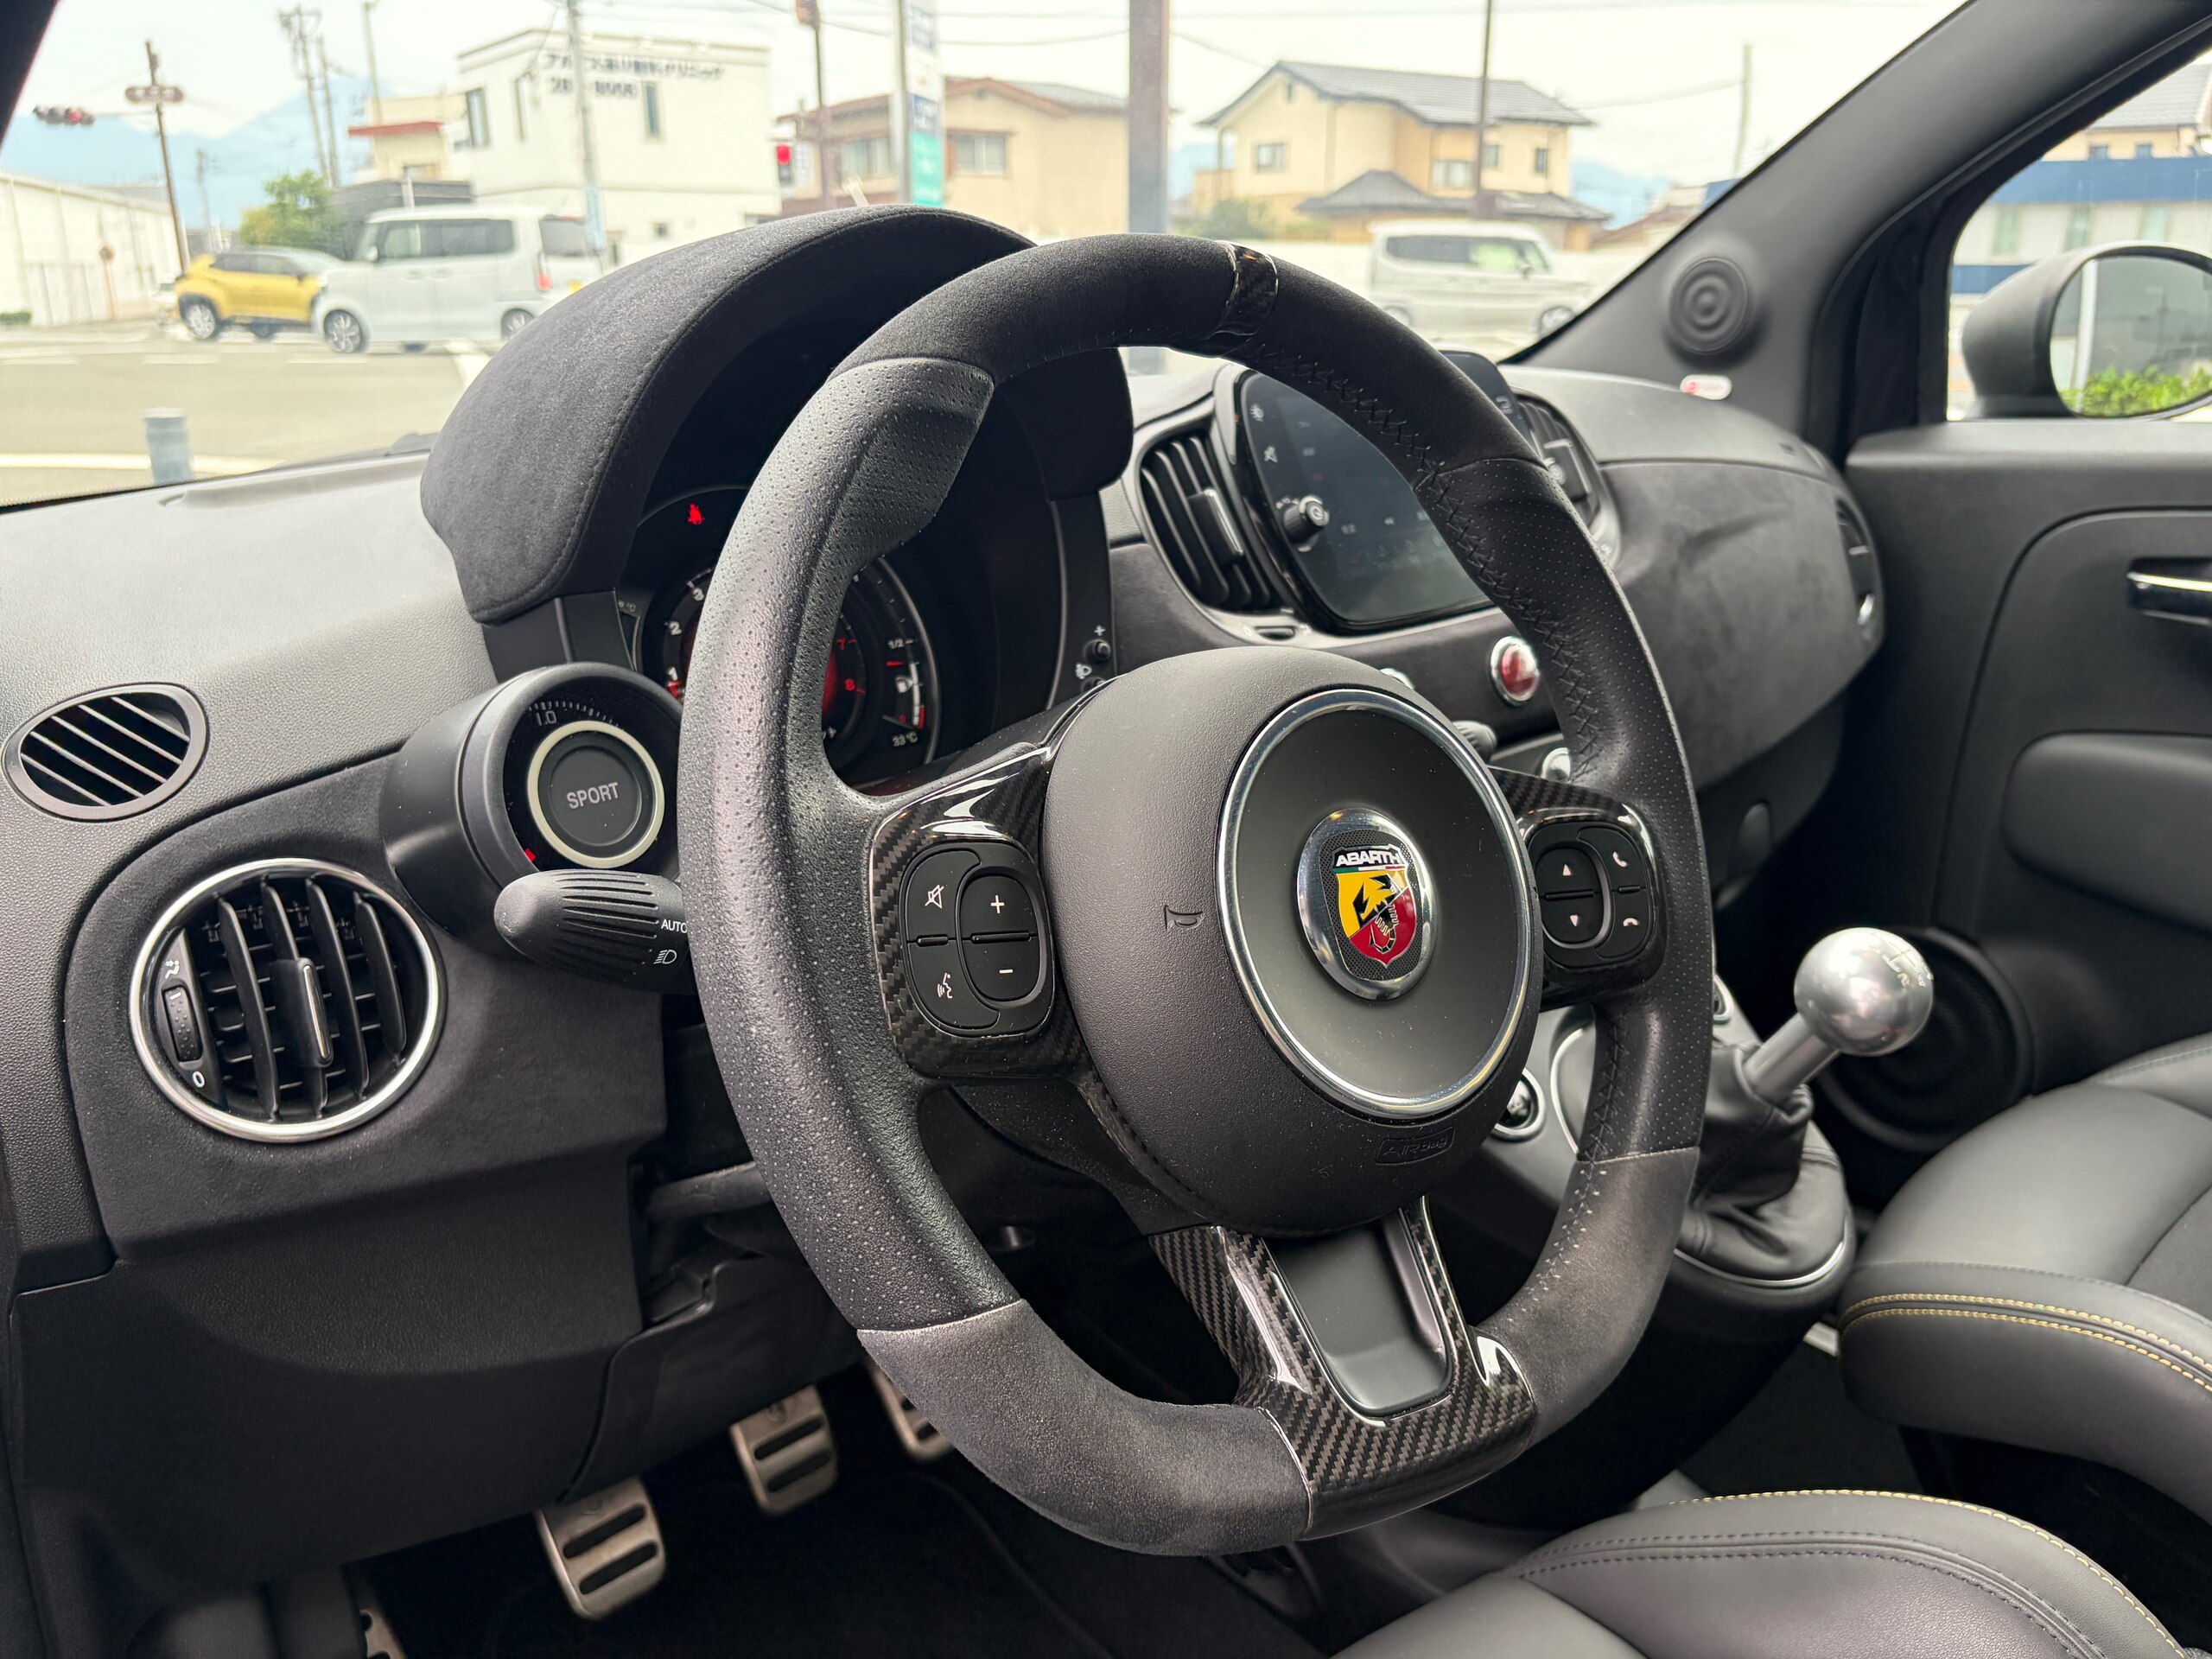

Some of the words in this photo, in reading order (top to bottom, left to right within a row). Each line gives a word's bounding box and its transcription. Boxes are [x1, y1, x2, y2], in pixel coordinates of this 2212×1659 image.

[669, 620, 683, 636] 2
[566, 781, 620, 810] SPORT
[1335, 849, 1403, 868] ABARTH
[660, 918, 689, 934] AUTO
